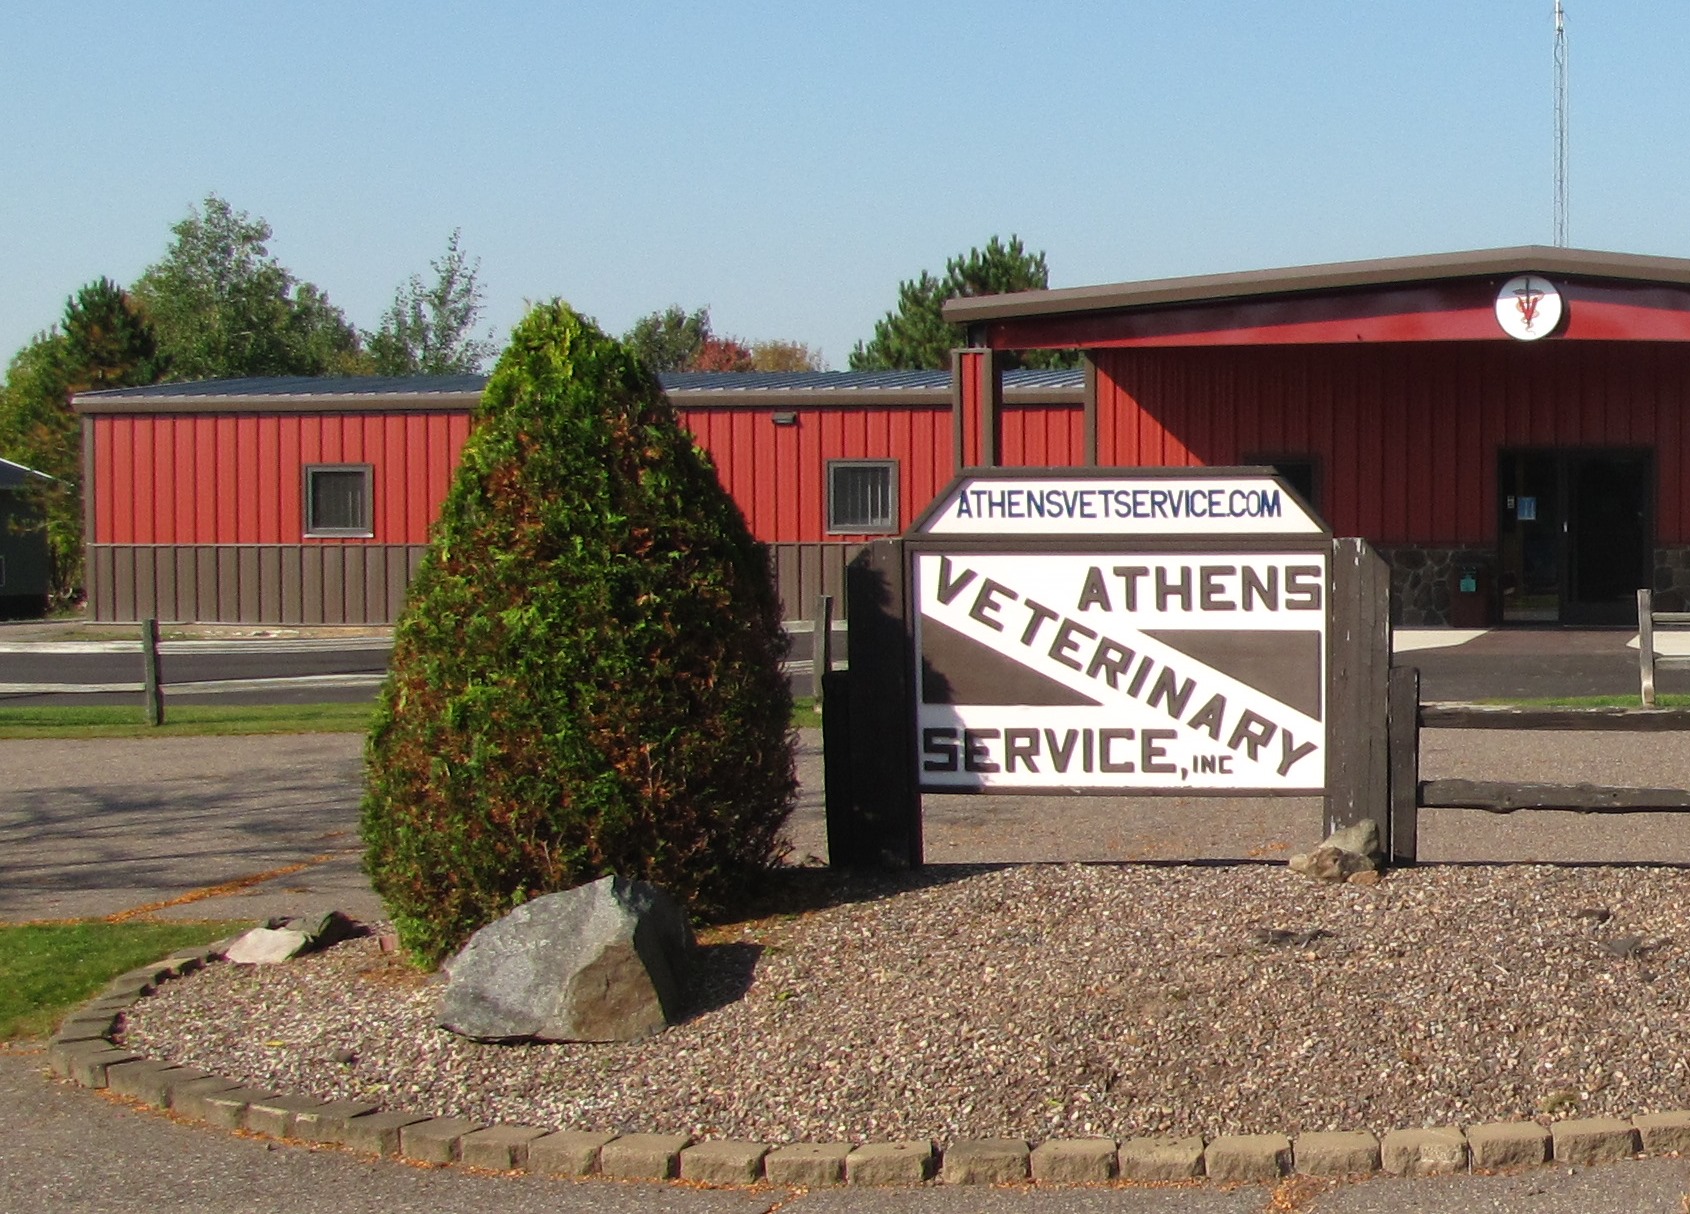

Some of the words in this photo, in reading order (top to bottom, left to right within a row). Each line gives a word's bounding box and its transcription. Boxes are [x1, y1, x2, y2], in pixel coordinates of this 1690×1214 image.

[957, 489, 1282, 518] ATHENSVETSERVICE.COM
[1077, 565, 1322, 612] ATHENS
[937, 555, 1317, 777] VETERINARY
[923, 728, 1189, 780] SERVICE,
[1193, 755, 1233, 774] INC
